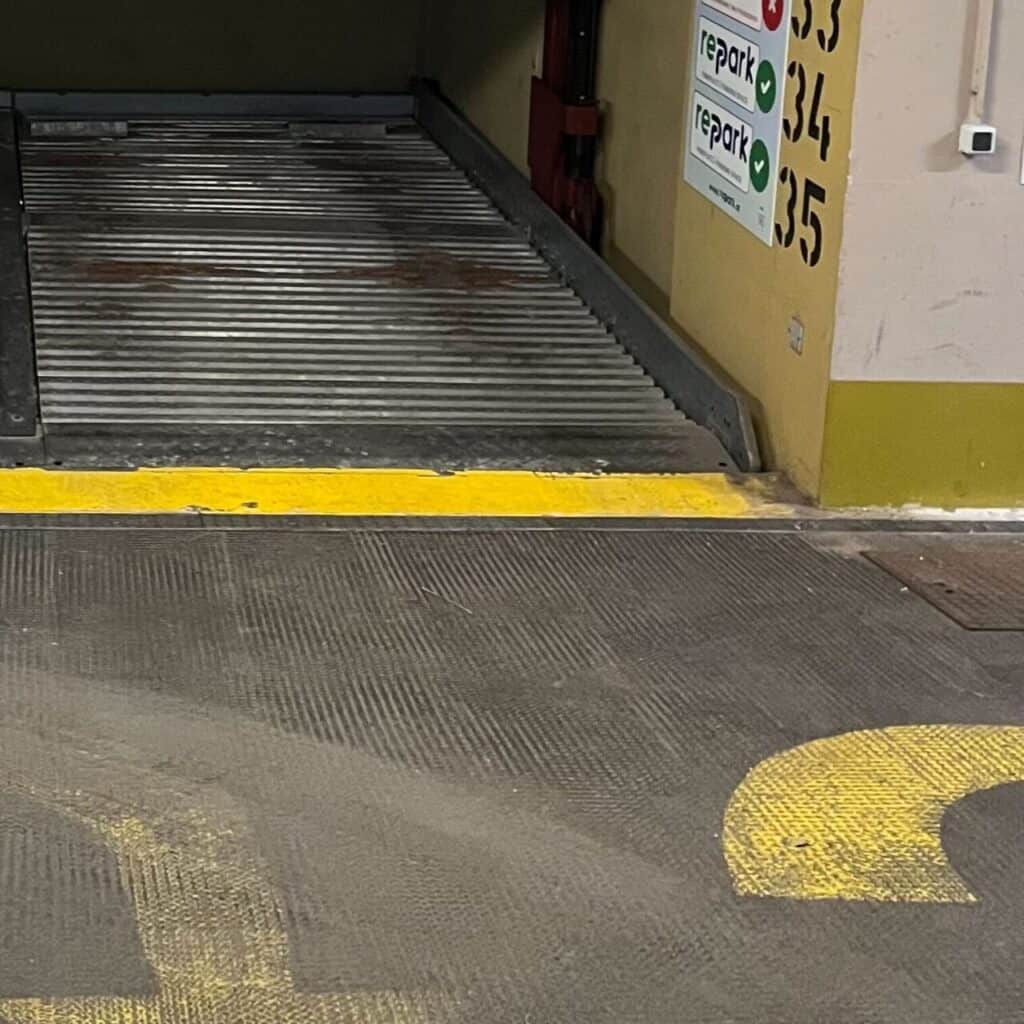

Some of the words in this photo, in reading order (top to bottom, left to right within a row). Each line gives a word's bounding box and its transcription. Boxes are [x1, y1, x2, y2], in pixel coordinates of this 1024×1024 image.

[700, 29, 755, 84] repark
[695, 103, 749, 163] repark
[782, 60, 830, 163] 34
[774, 166, 826, 267] 35
